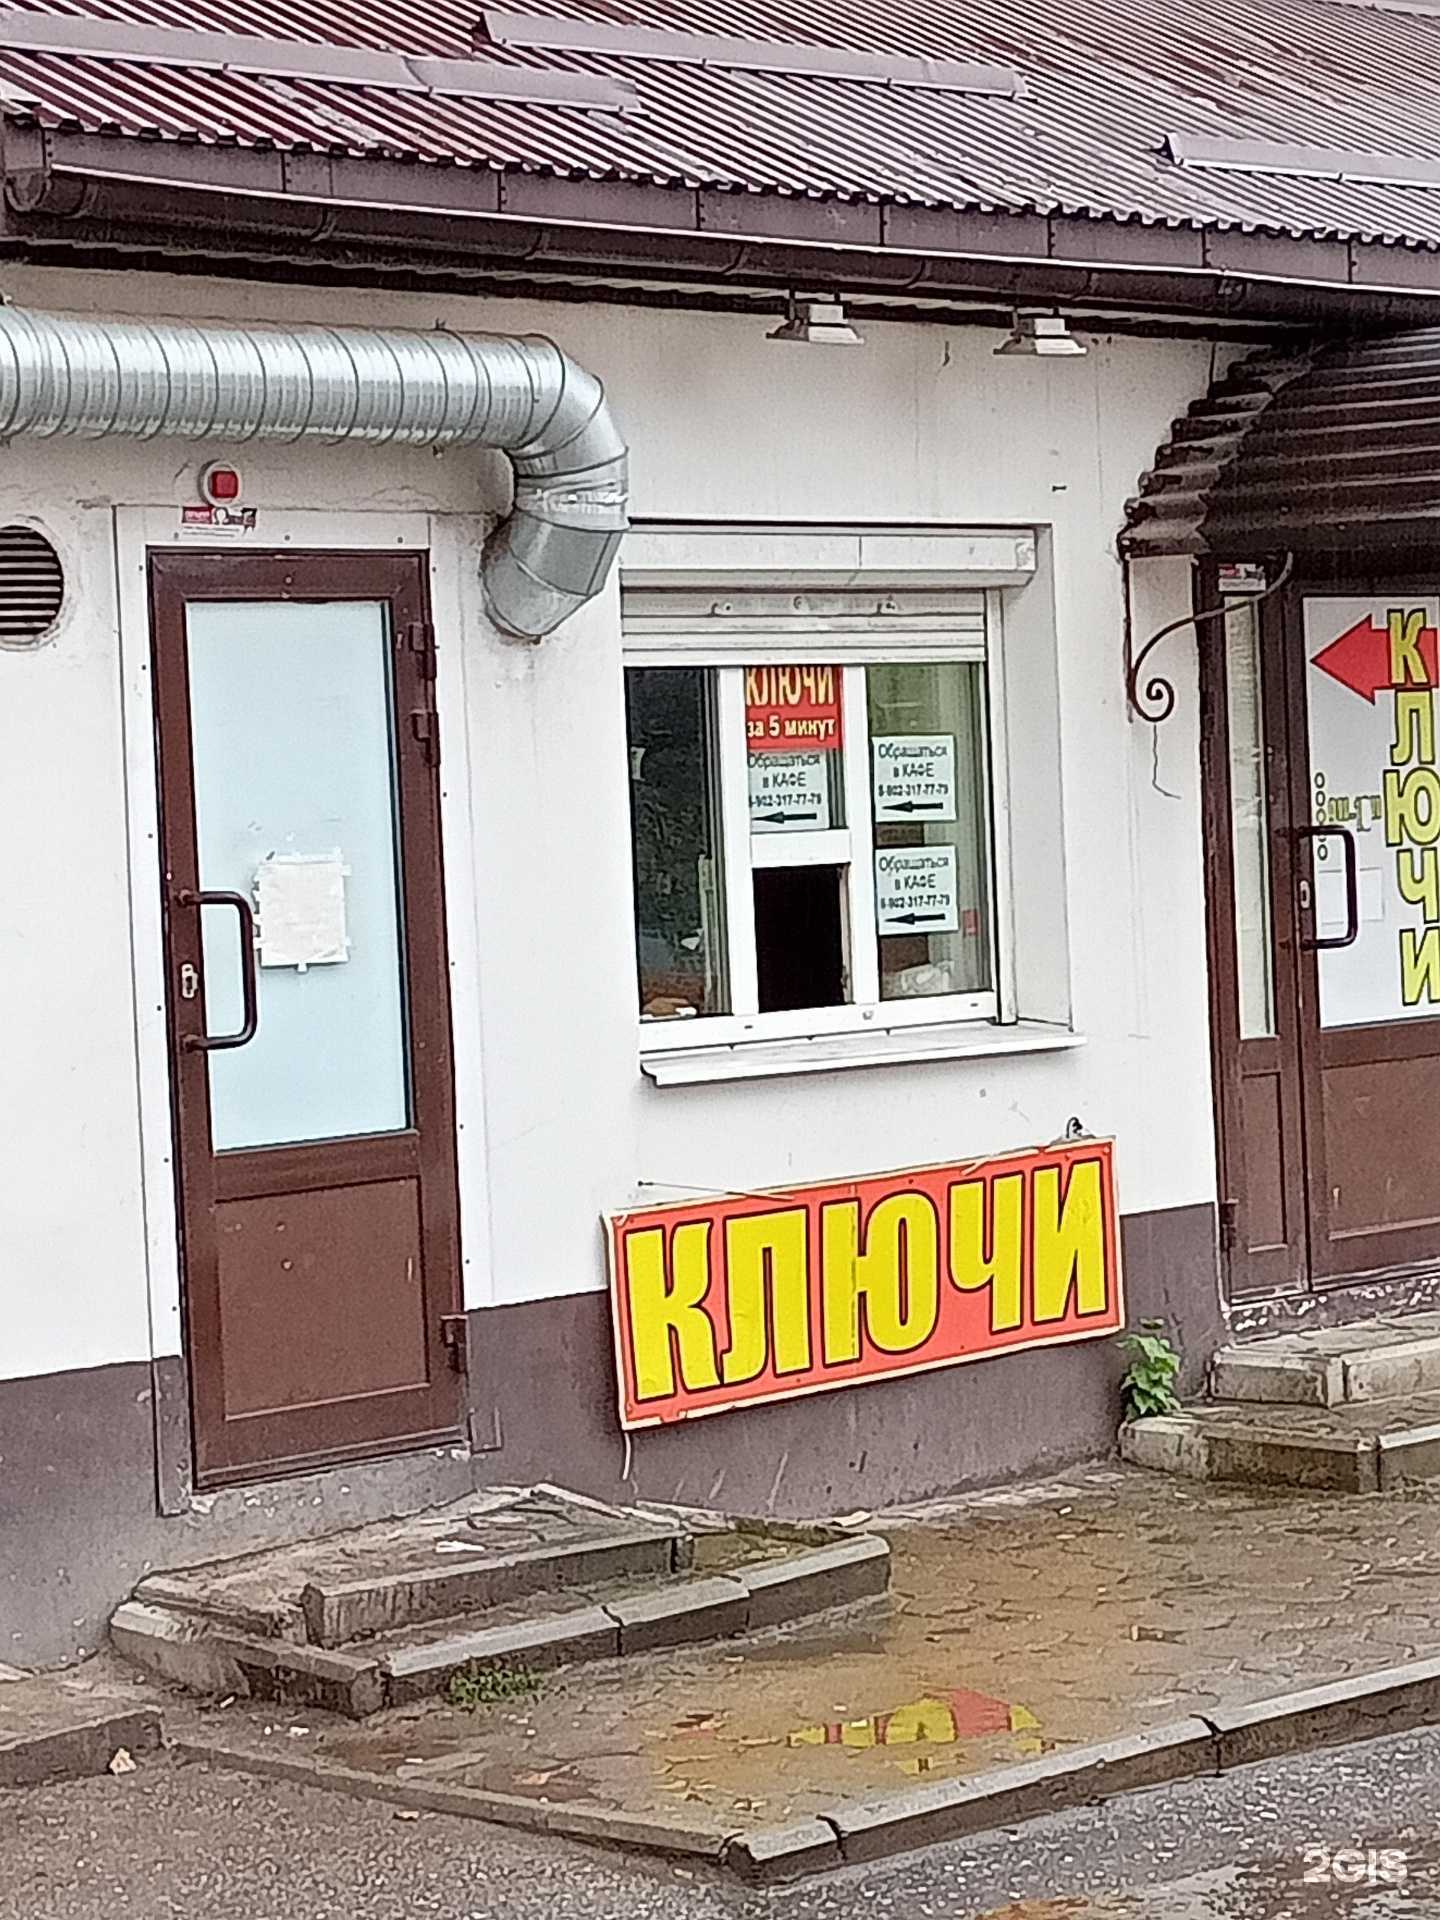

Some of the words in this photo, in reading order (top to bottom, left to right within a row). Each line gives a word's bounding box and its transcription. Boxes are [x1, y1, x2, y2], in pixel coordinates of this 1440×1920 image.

[745, 666, 835, 707] КЛЮЧИ
[746, 720, 764, 738] за
[768, 714, 781, 737] 5
[784, 718, 836, 741] минут
[747, 752, 821, 770] Обращаться
[878, 743, 949, 761] Обращаться
[893, 766, 900, 778] в
[902, 762, 935, 778] КАФЕ
[762, 776, 769, 789] в
[772, 771, 806, 788] КАФЕ
[1382, 608, 1440, 1007] КЛЮЧИ
[878, 856, 950, 873] Обращаться
[894, 878, 901, 891] в
[904, 873, 937, 890] КАФЕ
[623, 1158, 1107, 1403] КЛЮЧИ
